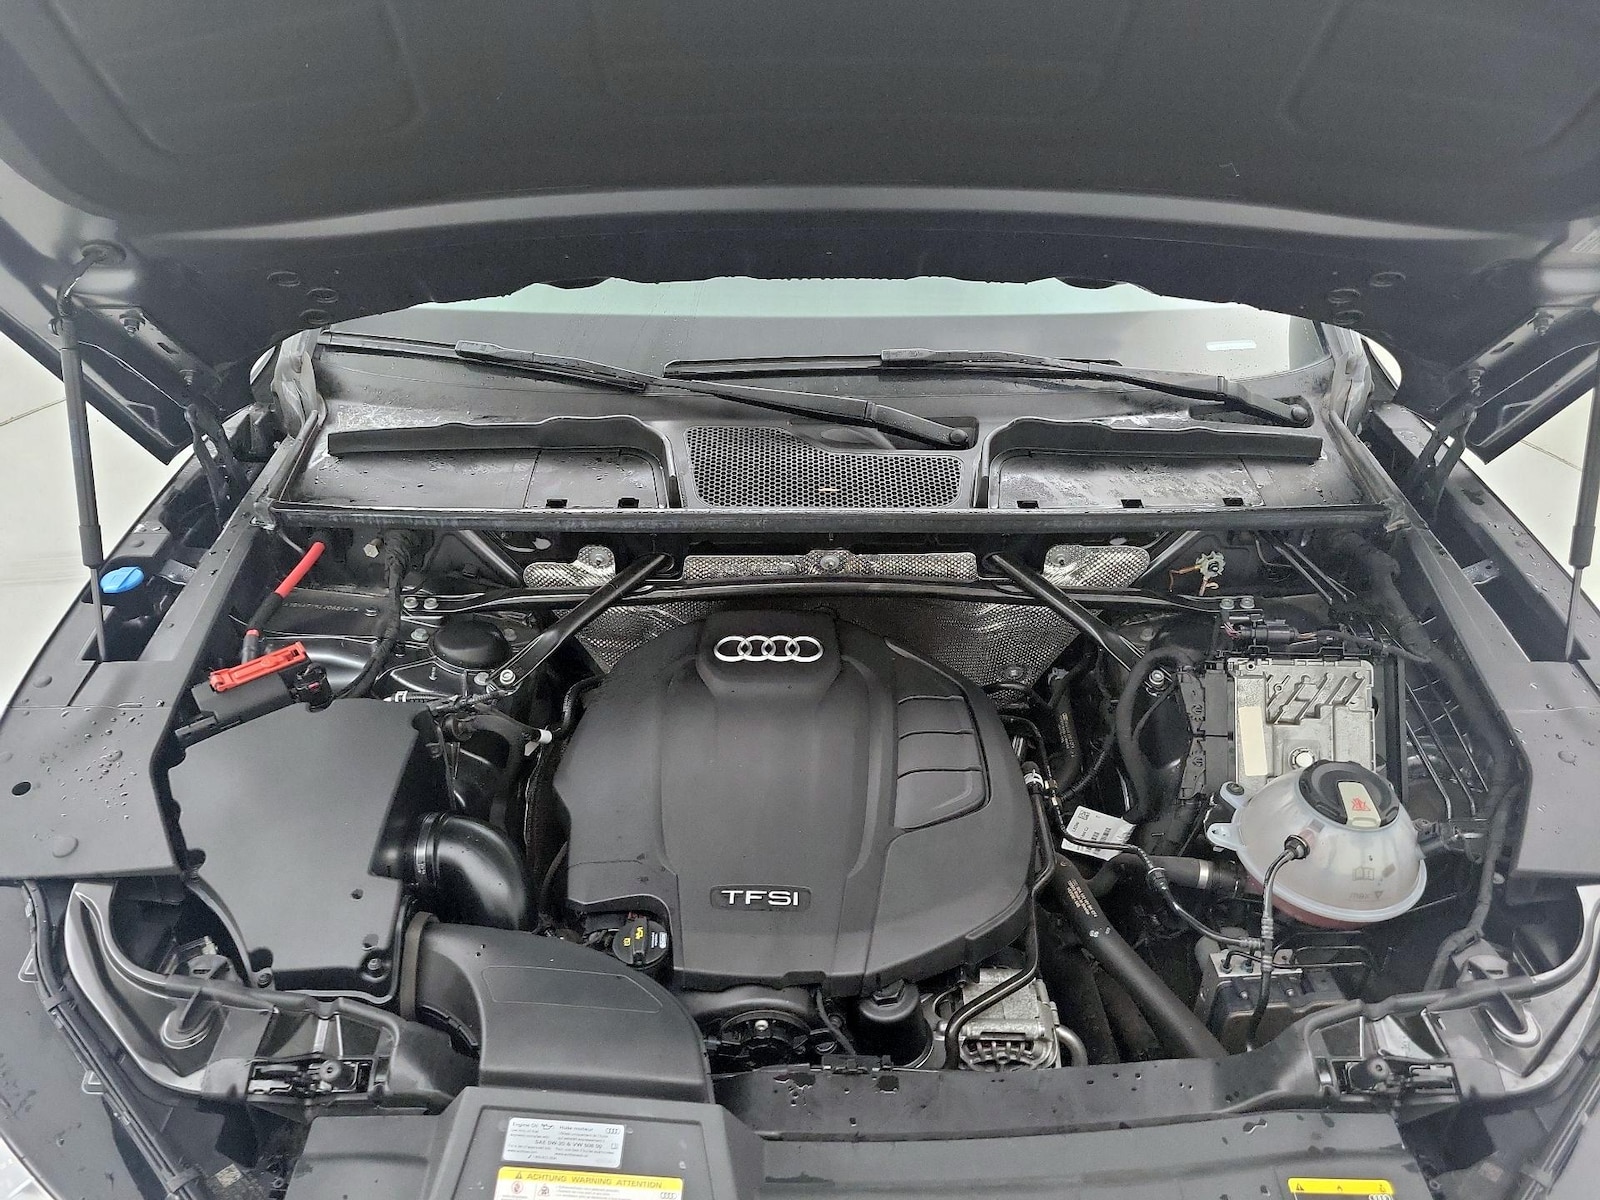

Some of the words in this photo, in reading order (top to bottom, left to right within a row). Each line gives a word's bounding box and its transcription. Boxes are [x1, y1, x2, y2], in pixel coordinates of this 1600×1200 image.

[721, 890, 799, 906] TFSI
[526, 1173, 567, 1182] ACHTUNG
[571, 1176, 612, 1186] WARNING
[615, 1179, 663, 1189] ATTENTION
